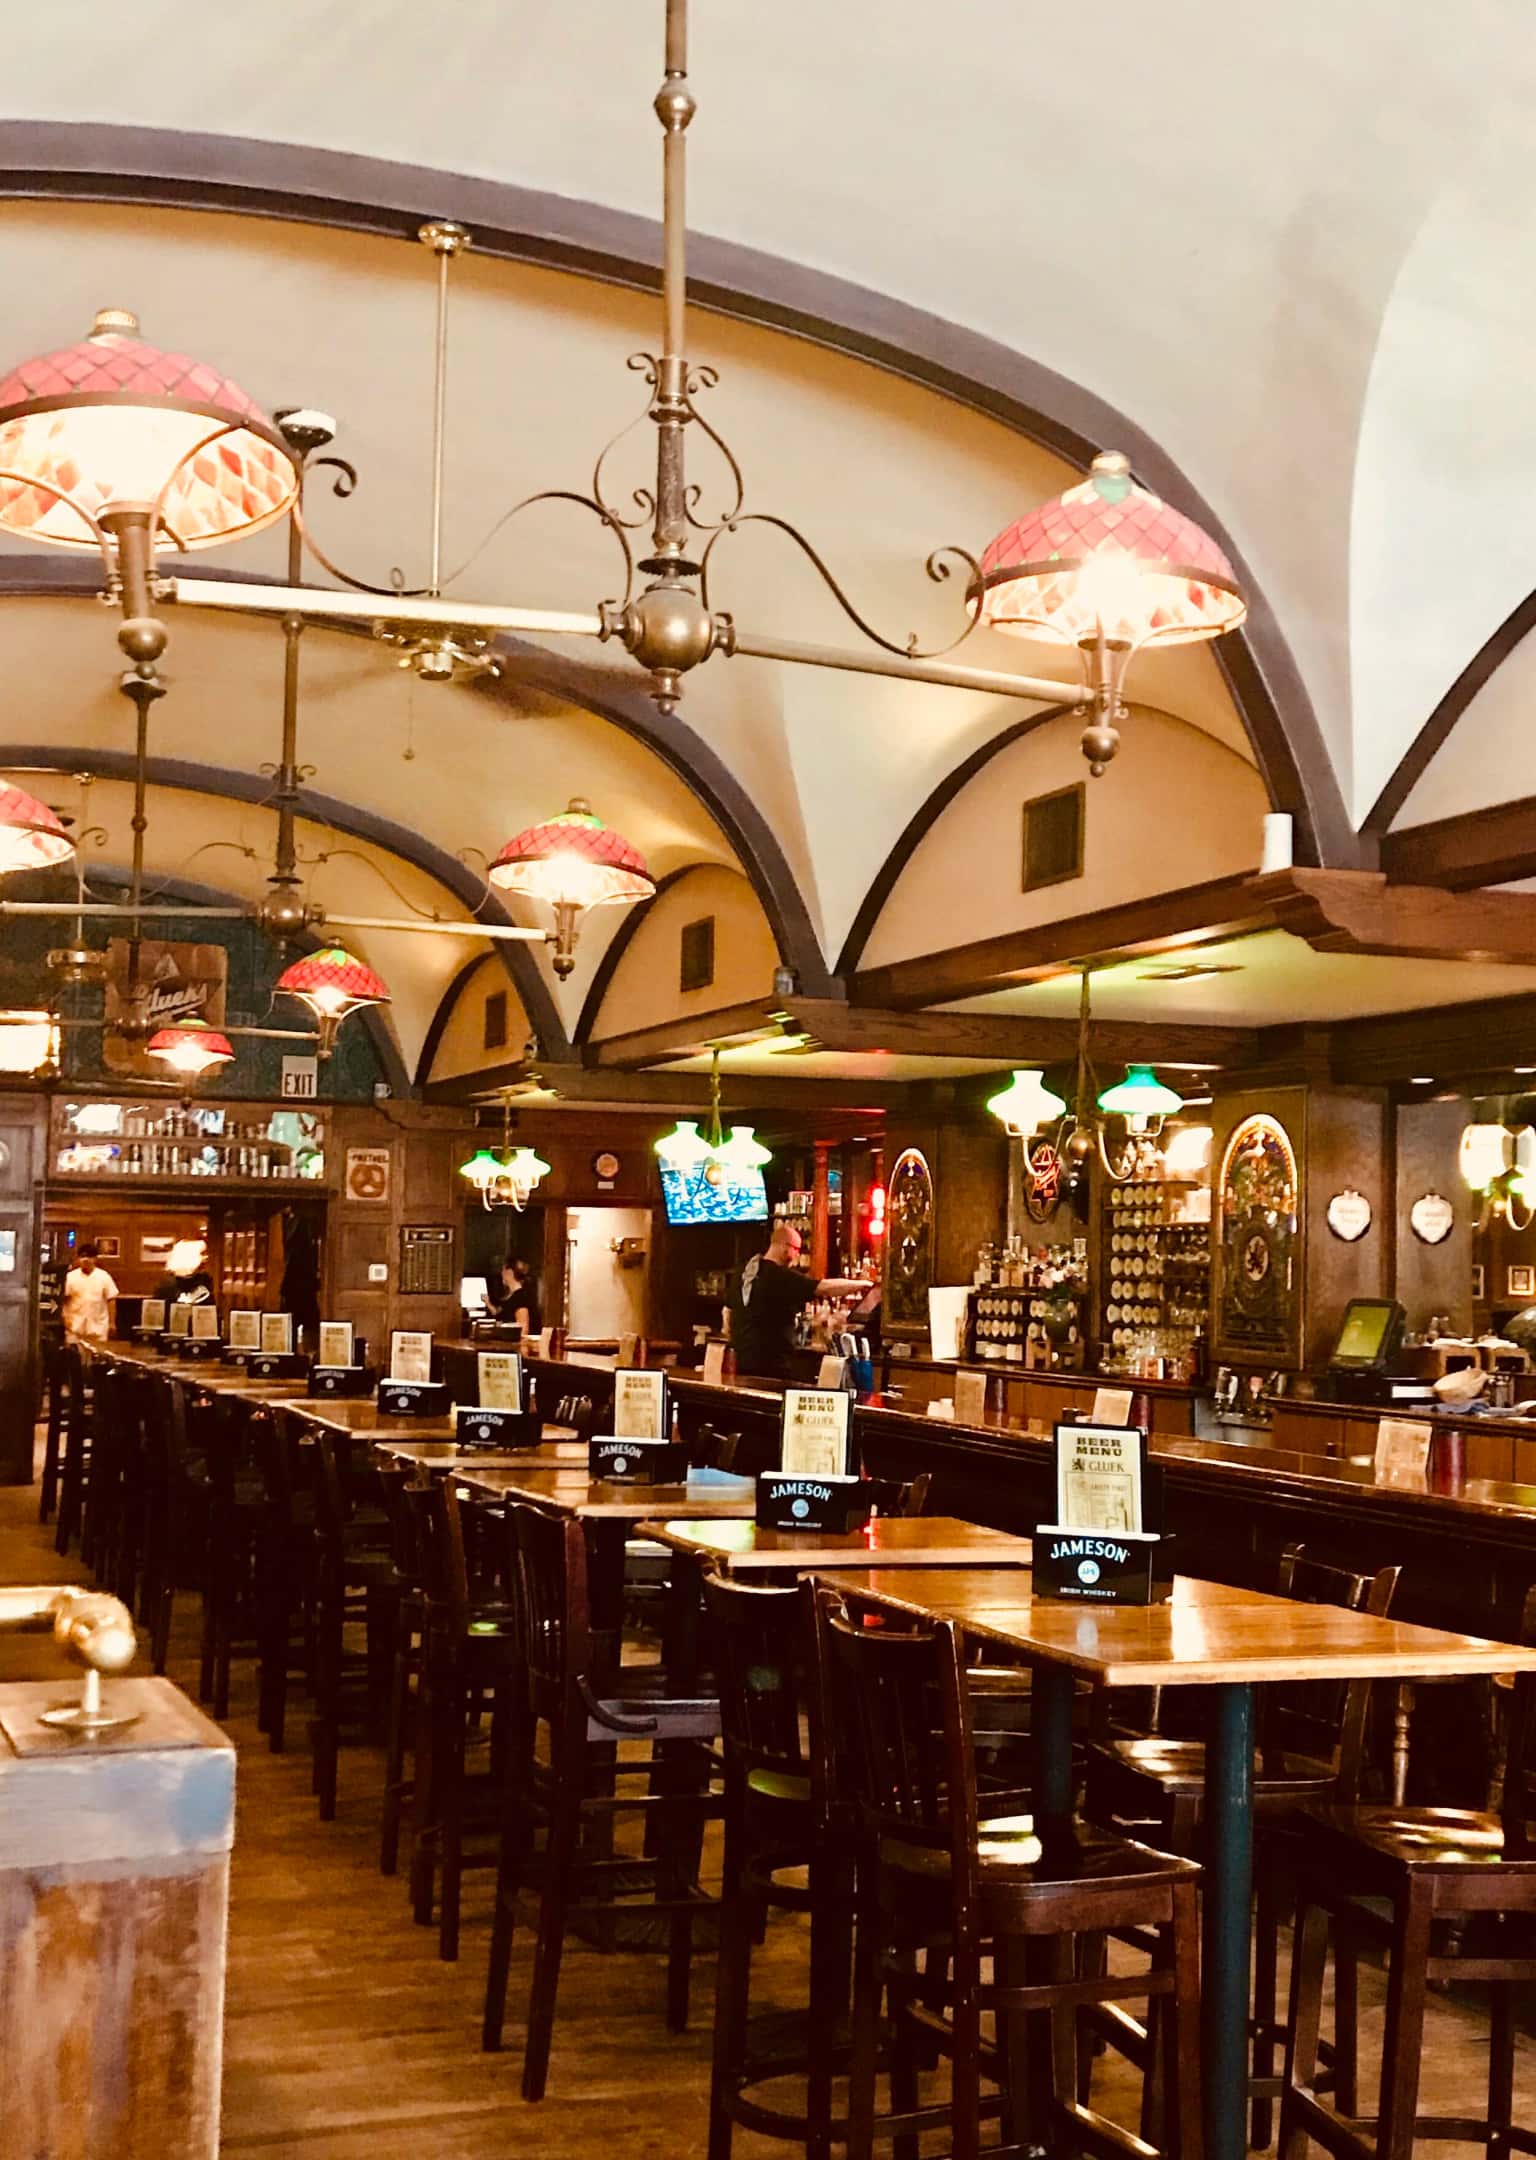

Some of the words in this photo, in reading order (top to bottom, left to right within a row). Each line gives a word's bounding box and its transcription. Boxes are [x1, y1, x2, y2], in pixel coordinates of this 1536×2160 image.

[285, 1073, 313, 1095] EXIT
[799, 1396, 834, 1404] BEER
[798, 1404, 835, 1412] MENU
[465, 1414, 504, 1426] JAMESON
[1077, 1437, 1121, 1447] BEER
[599, 1444, 643, 1459] JAMESON
[1076, 1446, 1122, 1457] MENU
[770, 1482, 832, 1502] JAMESON
[1050, 1539, 1128, 1564] JAMESON
